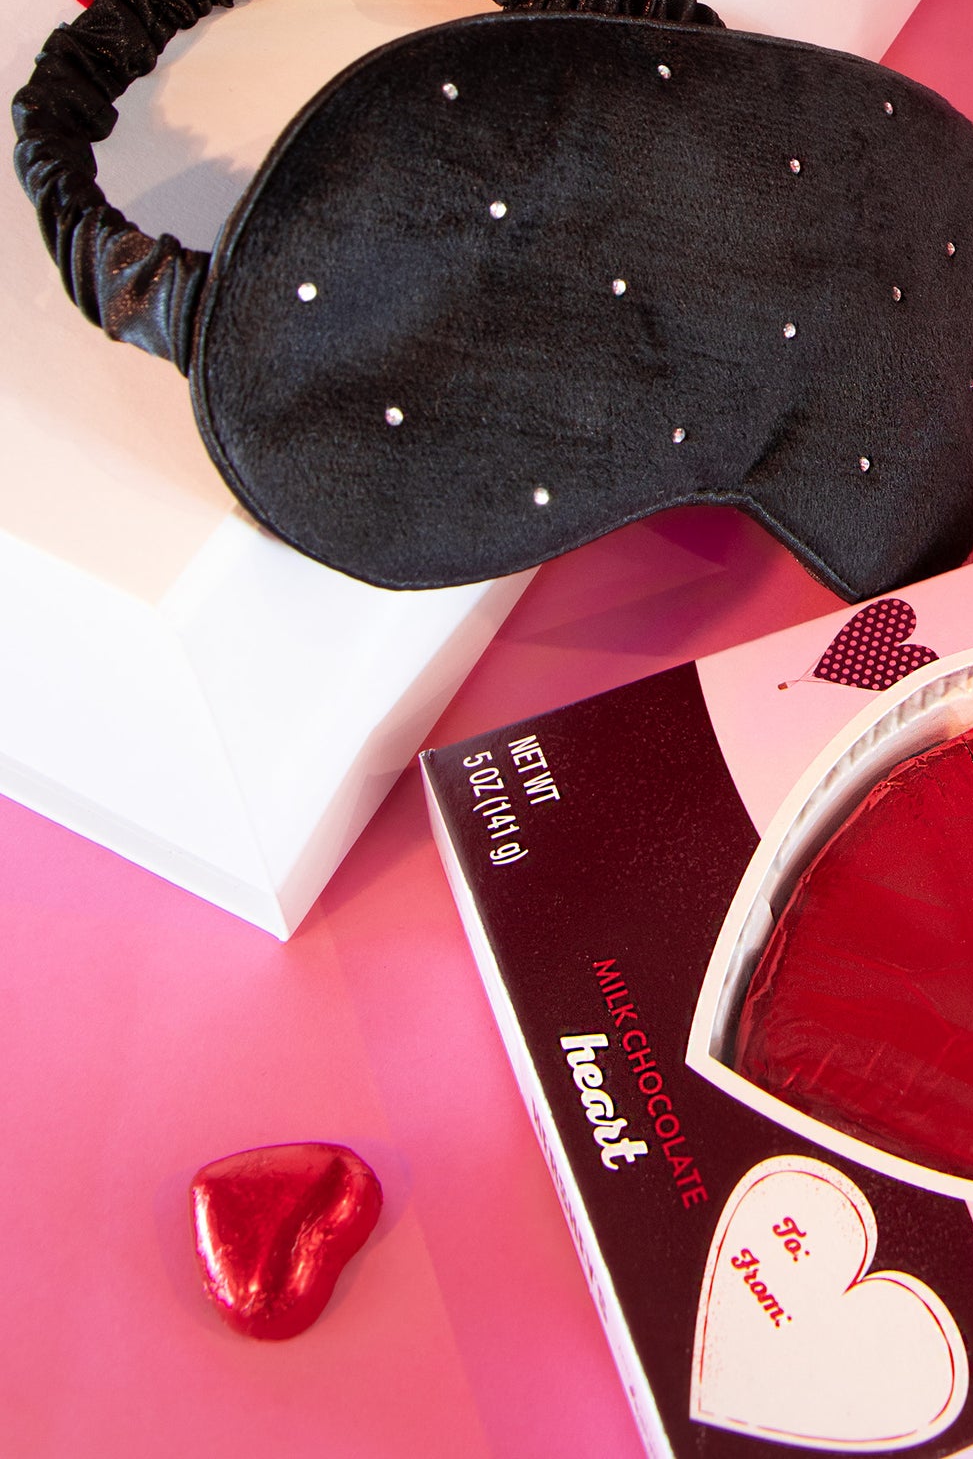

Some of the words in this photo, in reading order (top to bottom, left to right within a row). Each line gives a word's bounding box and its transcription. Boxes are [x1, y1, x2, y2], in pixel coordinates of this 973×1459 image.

[463, 751, 493, 768] 5
[508, 734, 548, 773] NET
[469, 767, 505, 797] OZ
[523, 771, 561, 805] WT
[473, 796, 520, 839] (141
[489, 842, 529, 866] g)
[560, 1033, 649, 1172] heart
[592, 958, 639, 1028] MILK
[622, 1029, 709, 1210] CHOCOLATE
[772, 1216, 810, 1262] To:
[730, 1248, 793, 1329] From:
